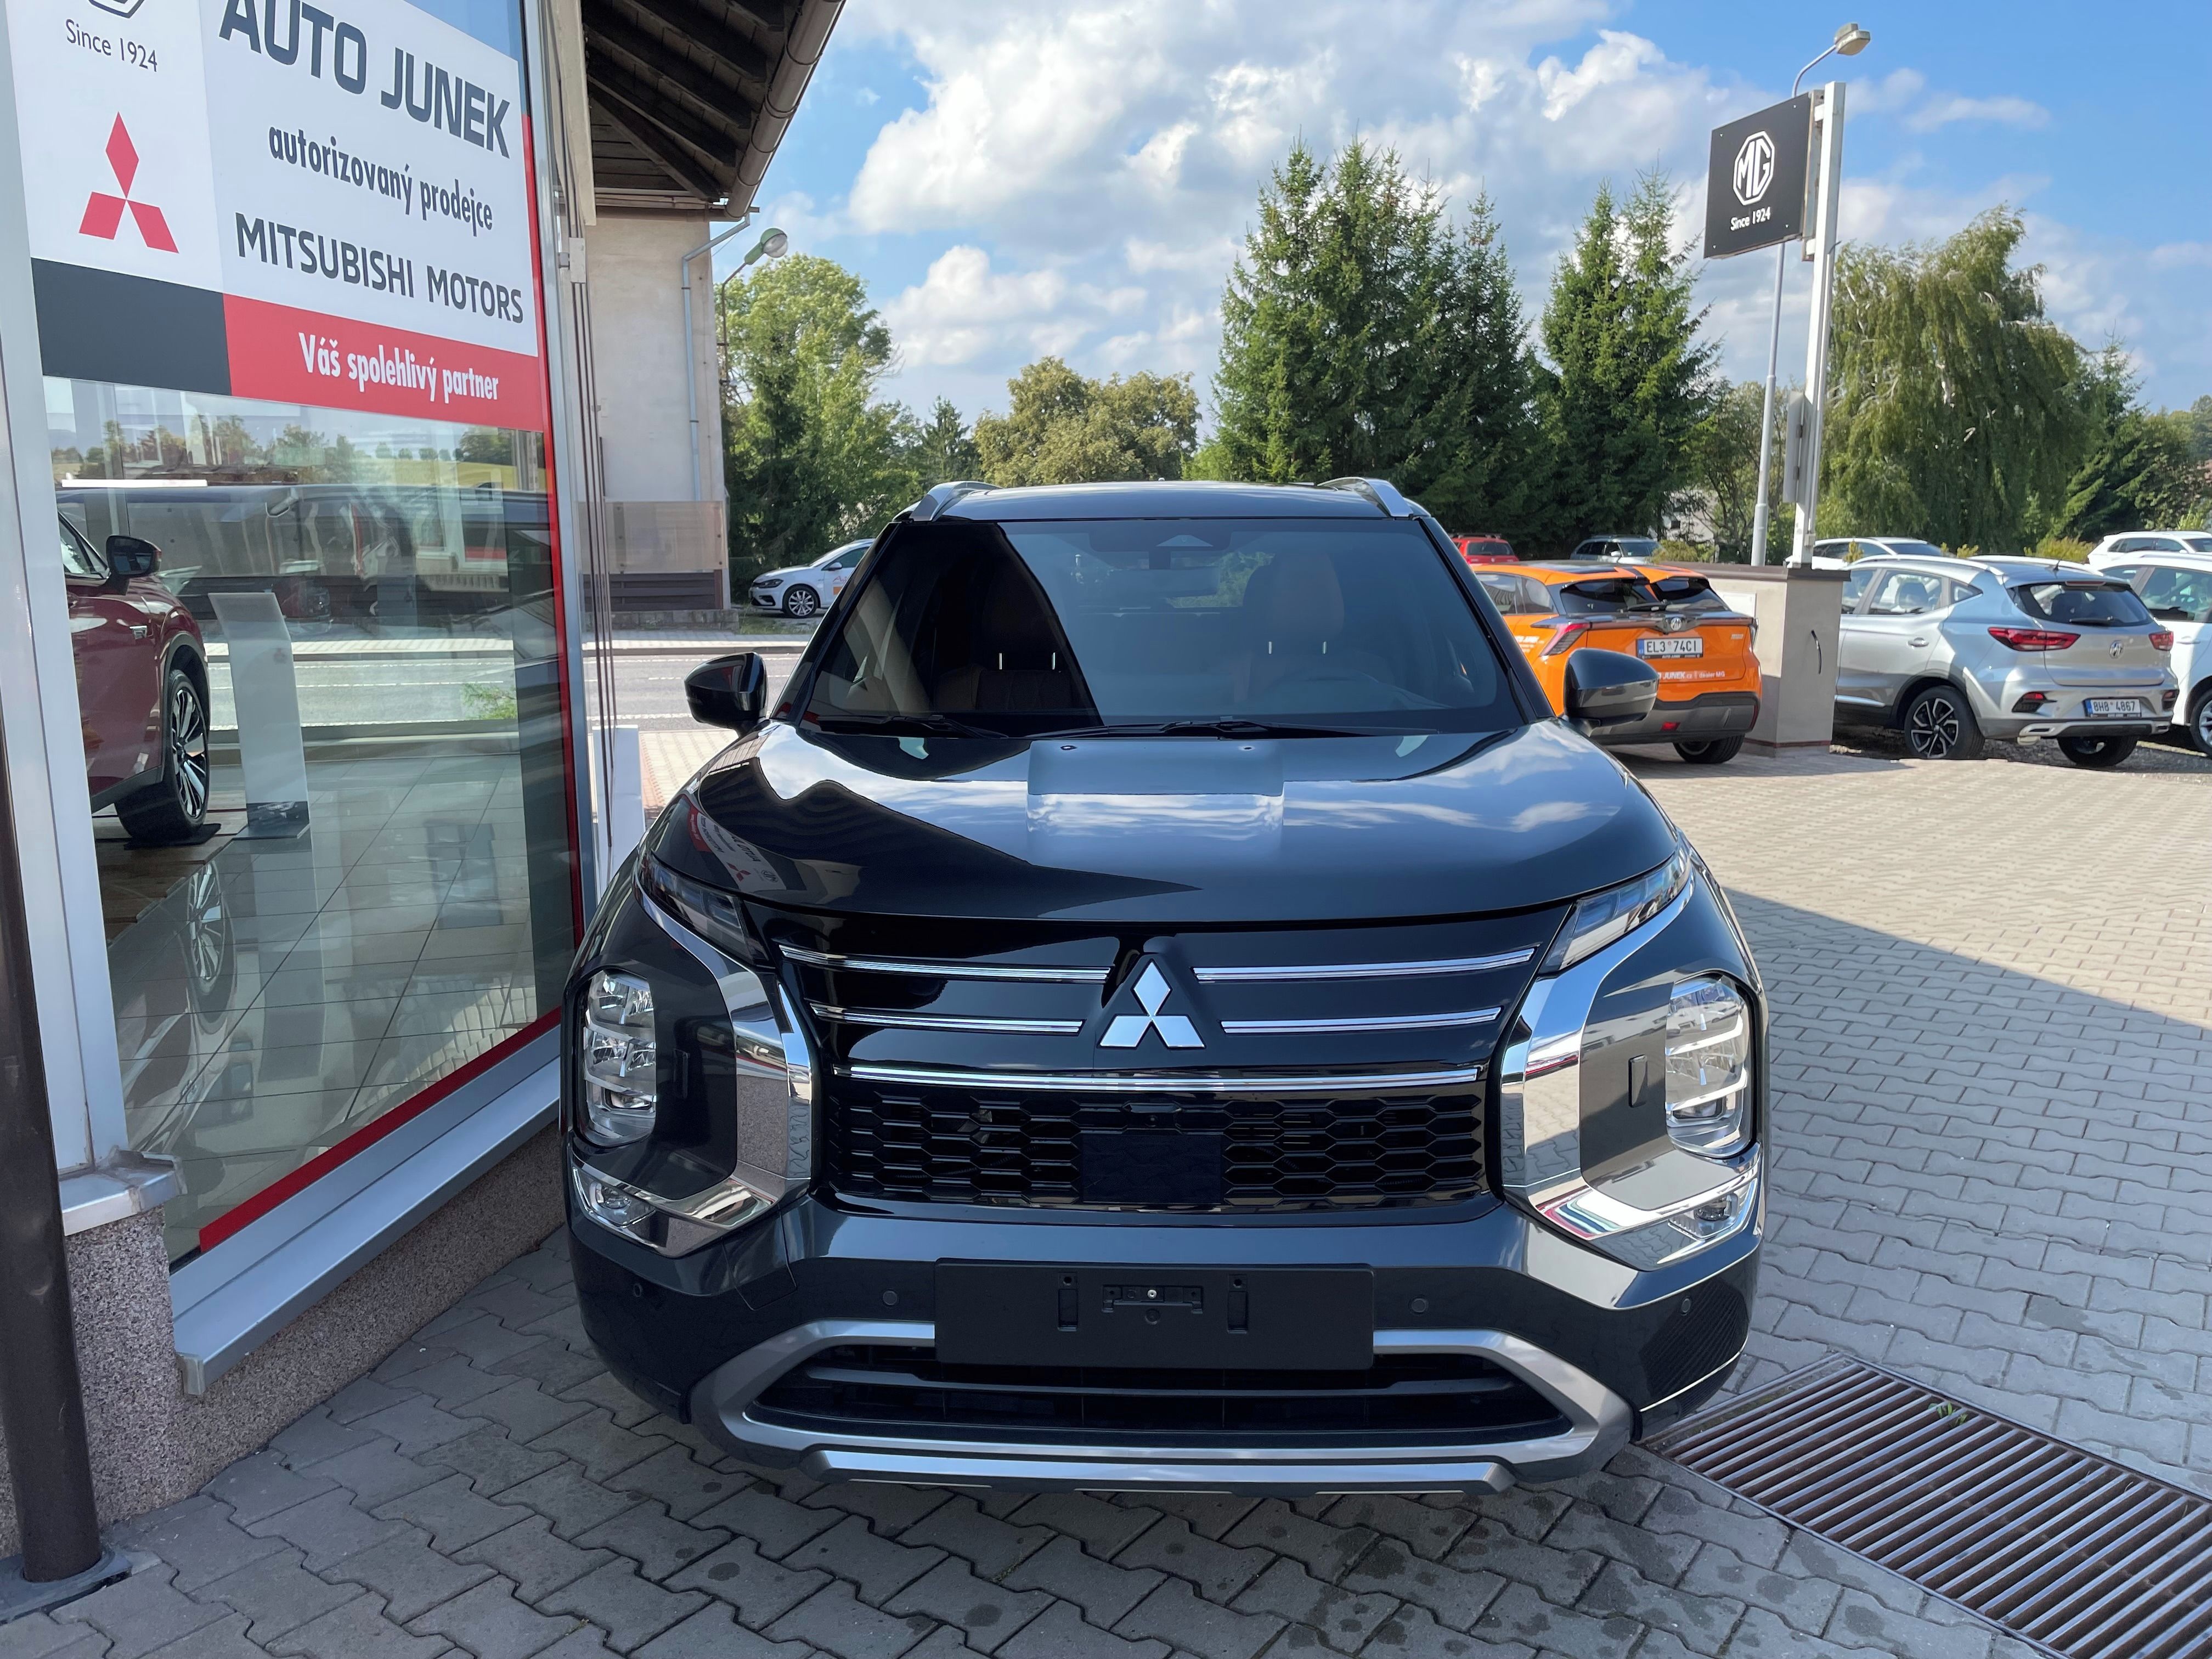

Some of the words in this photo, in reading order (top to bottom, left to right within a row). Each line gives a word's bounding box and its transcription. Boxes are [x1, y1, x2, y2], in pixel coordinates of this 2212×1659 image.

[66, 19, 111, 56] Since
[120, 37, 157, 72] 1924
[219, 0, 366, 94] AUTO
[381, 47, 510, 159] JUNEK
[269, 127, 412, 215] autorizovaný
[420, 179, 493, 237] prodejce
[1736, 137, 1771, 199] MG
[1730, 217, 1750, 231] Since
[1752, 206, 1771, 224] 1924
[235, 212, 414, 298] MITSUBISHI
[426, 265, 523, 324] MOTORS
[298, 332, 341, 377] Váš
[348, 345, 437, 402] spolehlivý
[443, 368, 499, 404] partner
[1647, 641, 1666, 653] EL3
